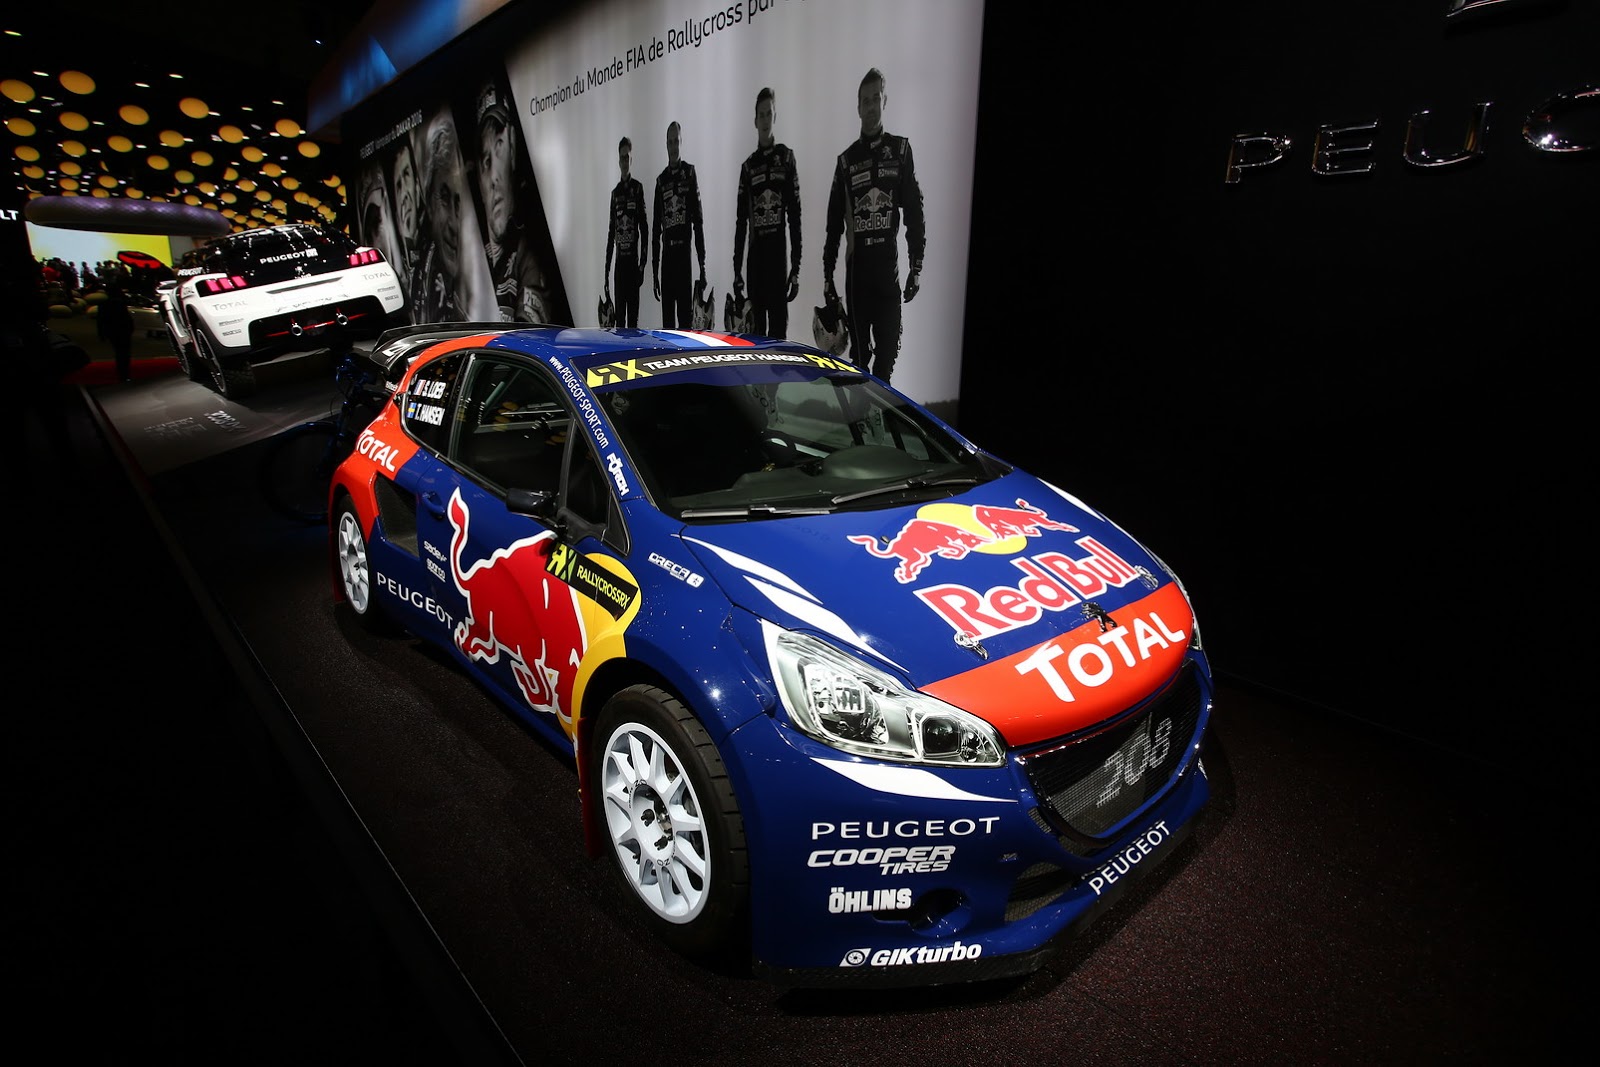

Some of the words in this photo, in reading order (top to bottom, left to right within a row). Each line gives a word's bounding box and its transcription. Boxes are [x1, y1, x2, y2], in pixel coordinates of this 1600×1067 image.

[529, 85, 571, 116] Champion
[573, 75, 585, 97] du
[587, 55, 623, 90] Monde
[626, 45, 646, 73] FIA
[648, 37, 664, 63] de
[667, 2, 743, 54] Rallycross
[854, 212, 874, 232] Red
[874, 210, 893, 230] Bull
[259, 250, 306, 265] PEUGEOT
[363, 271, 391, 281] TOTAL
[212, 300, 248, 311] TOTAL
[643, 358, 691, 370] TEAM
[689, 353, 754, 364] PEUGEOT
[755, 353, 809, 363] HANSEN
[549, 356, 609, 449] www.PEUGEOT-SPORT.com
[357, 429, 399, 472] TOTAL
[648, 552, 691, 579] ORECA
[376, 571, 454, 629] PEUGEOT
[576, 564, 631, 610] RALLYCROSSRX
[913, 557, 1083, 641] Red
[1031, 535, 1142, 600] Bull
[1014, 611, 1186, 703] TOTAL
[811, 816, 1000, 840] PEUGEOT
[807, 845, 956, 868] COOPER
[879, 859, 951, 876] TIRES
[1088, 820, 1170, 897] PEUGEOT
[828, 886, 912, 914] ÖHLINS
